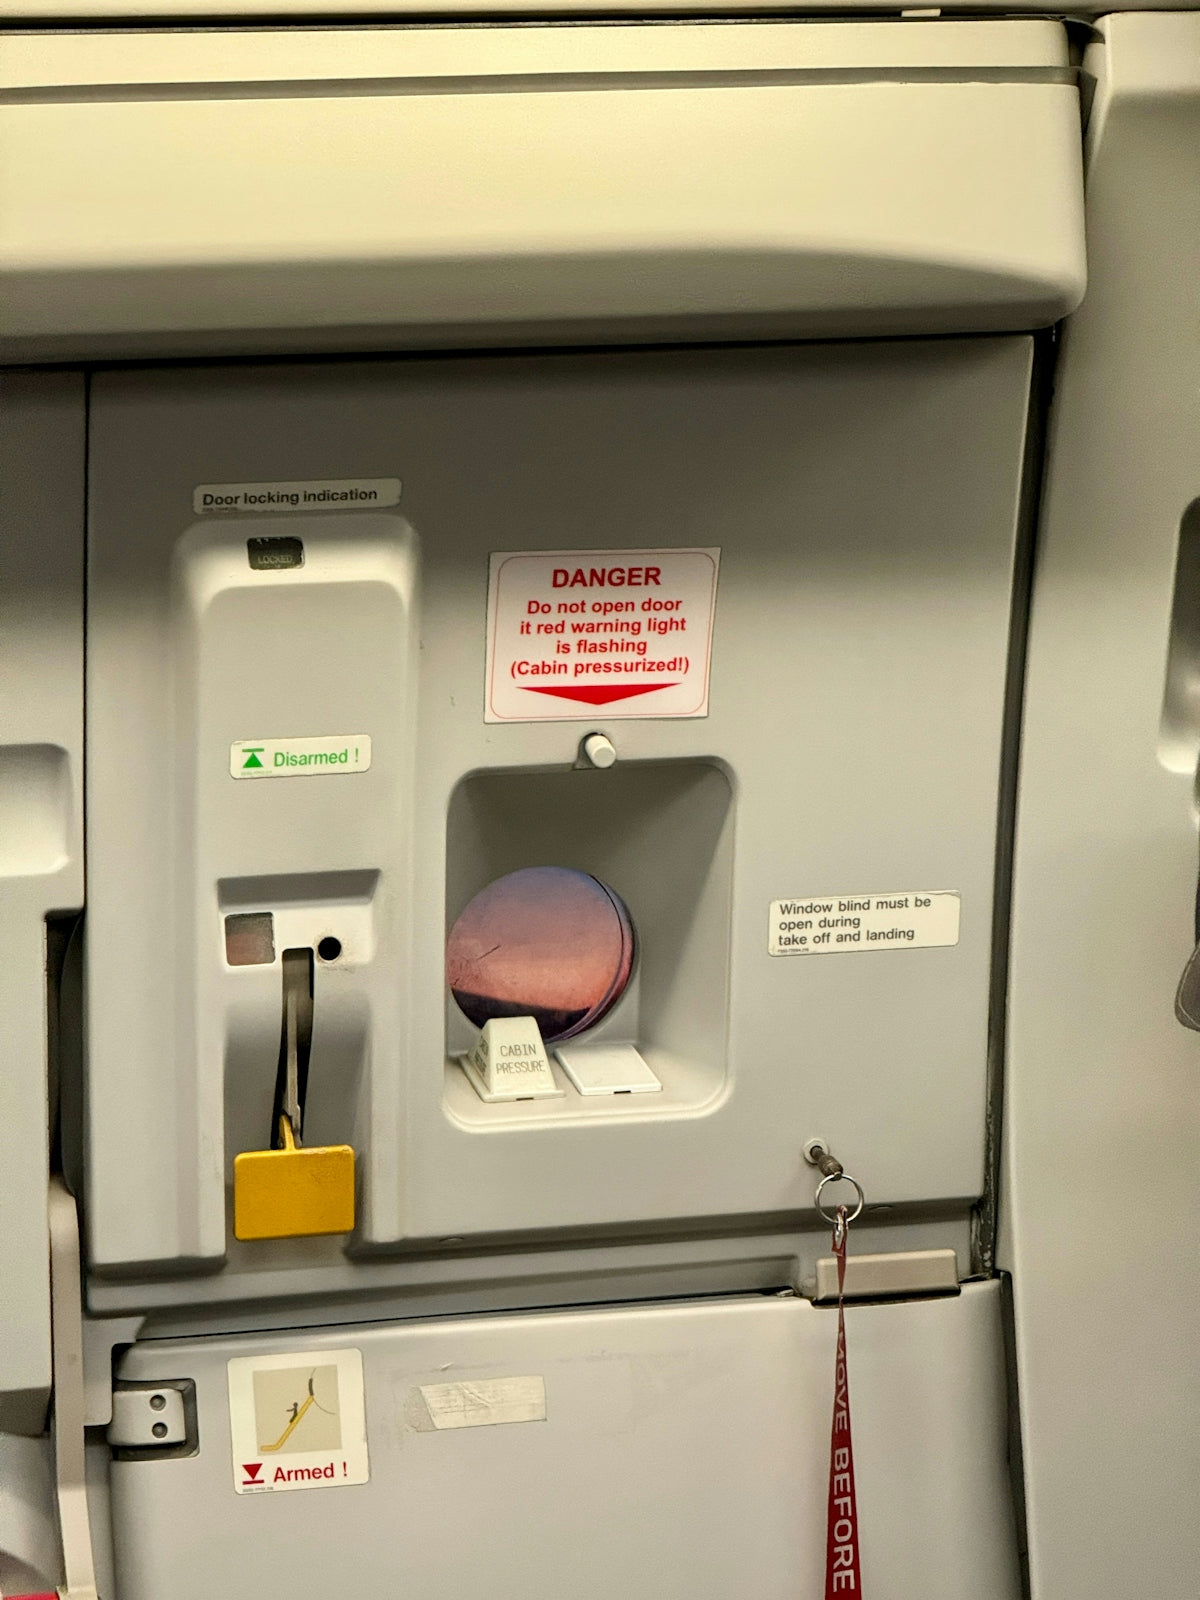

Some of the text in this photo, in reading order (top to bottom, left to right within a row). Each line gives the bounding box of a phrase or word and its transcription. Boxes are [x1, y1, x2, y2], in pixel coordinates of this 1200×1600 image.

[203, 488, 378, 506] Door locking indication
[552, 566, 662, 588] DANGER
[527, 598, 683, 616] Do not open door
[520, 617, 686, 636] it red warning light
[556, 638, 647, 655] is flashing
[510, 656, 690, 679] (Cabin pressurized!)
[274, 748, 348, 767] Disarmed
[779, 897, 931, 915] Window blind must be
[779, 916, 861, 932] open during
[778, 928, 915, 946] take off and landing
[500, 1043, 537, 1057] CABIN
[496, 1060, 545, 1074] PRESSURE
[273, 1462, 335, 1483] Armed
[832, 1447, 855, 1593] BEFORE
